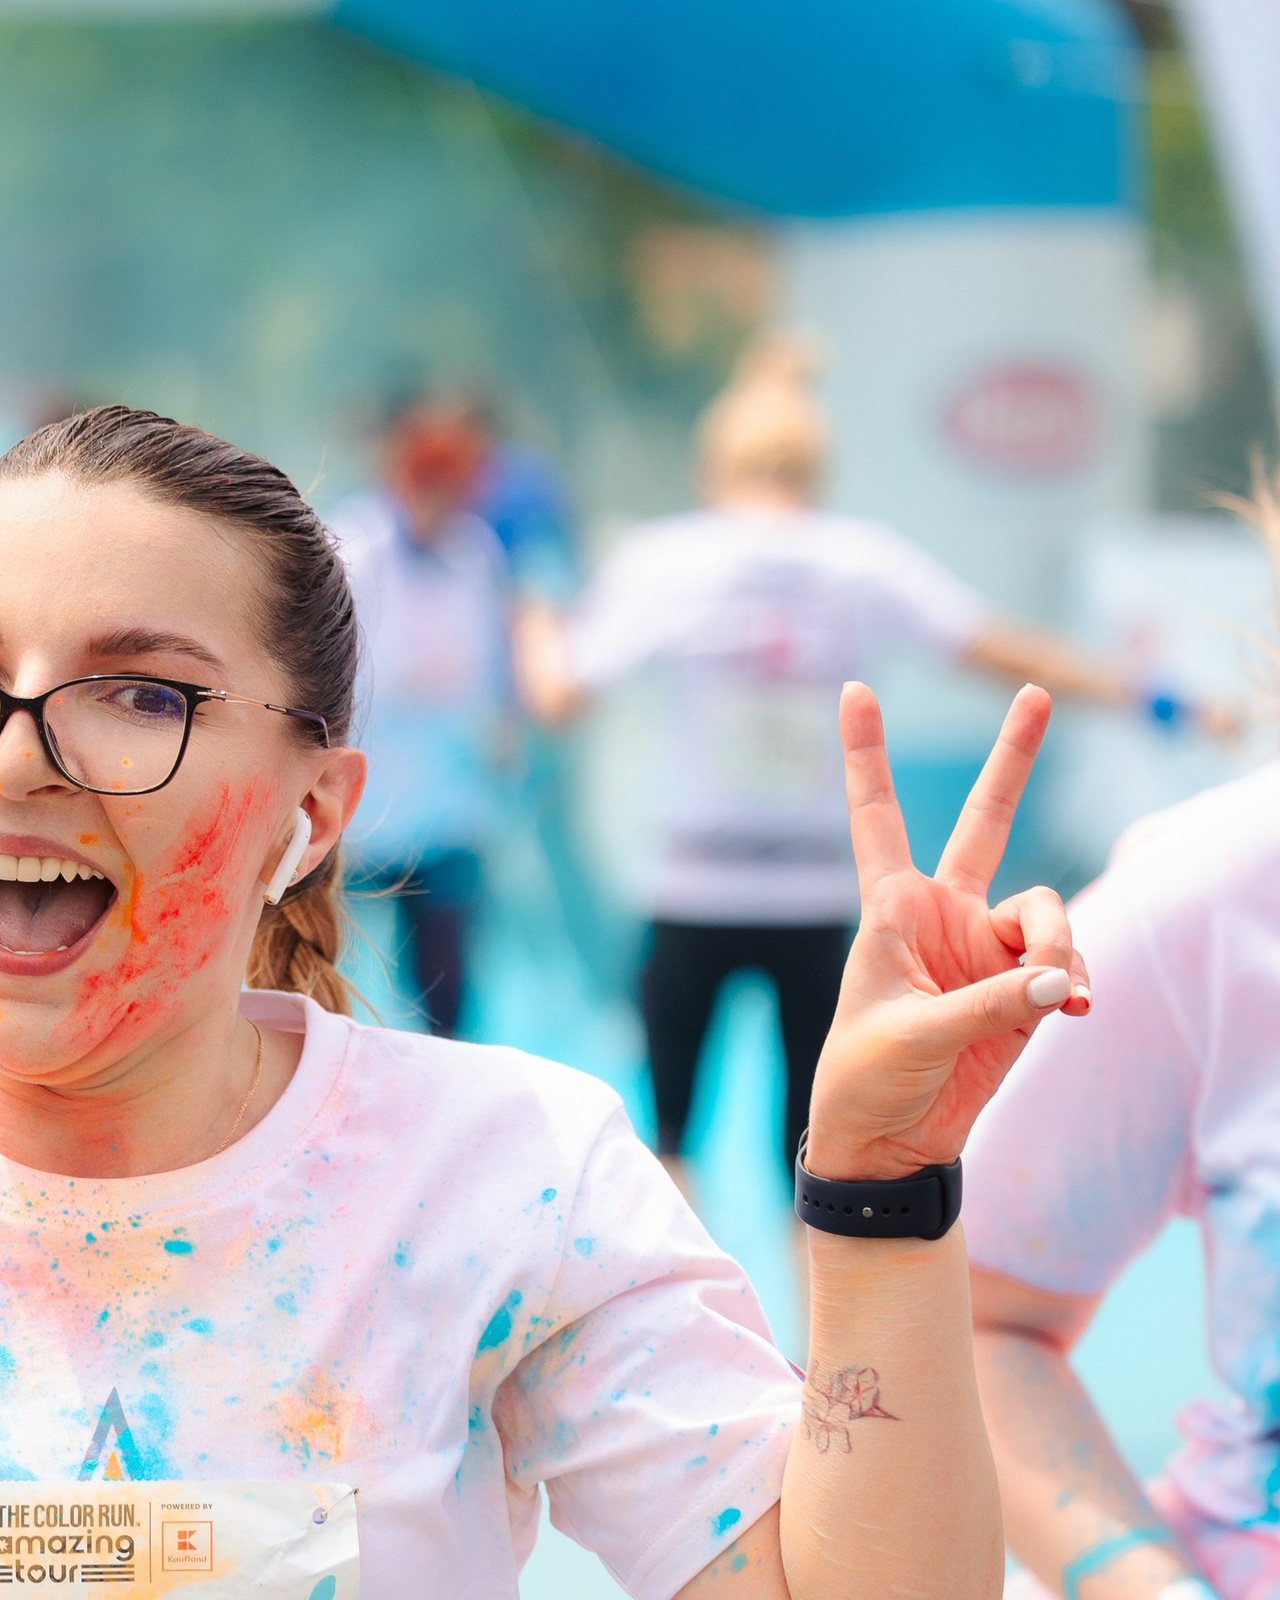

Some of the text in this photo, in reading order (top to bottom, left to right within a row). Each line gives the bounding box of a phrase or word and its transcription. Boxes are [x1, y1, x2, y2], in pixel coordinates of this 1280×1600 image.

[33, 1504, 94, 1528] COLOR
[167, 1555, 207, 1563] Kaufland
[15, 1559, 78, 1584] tour
